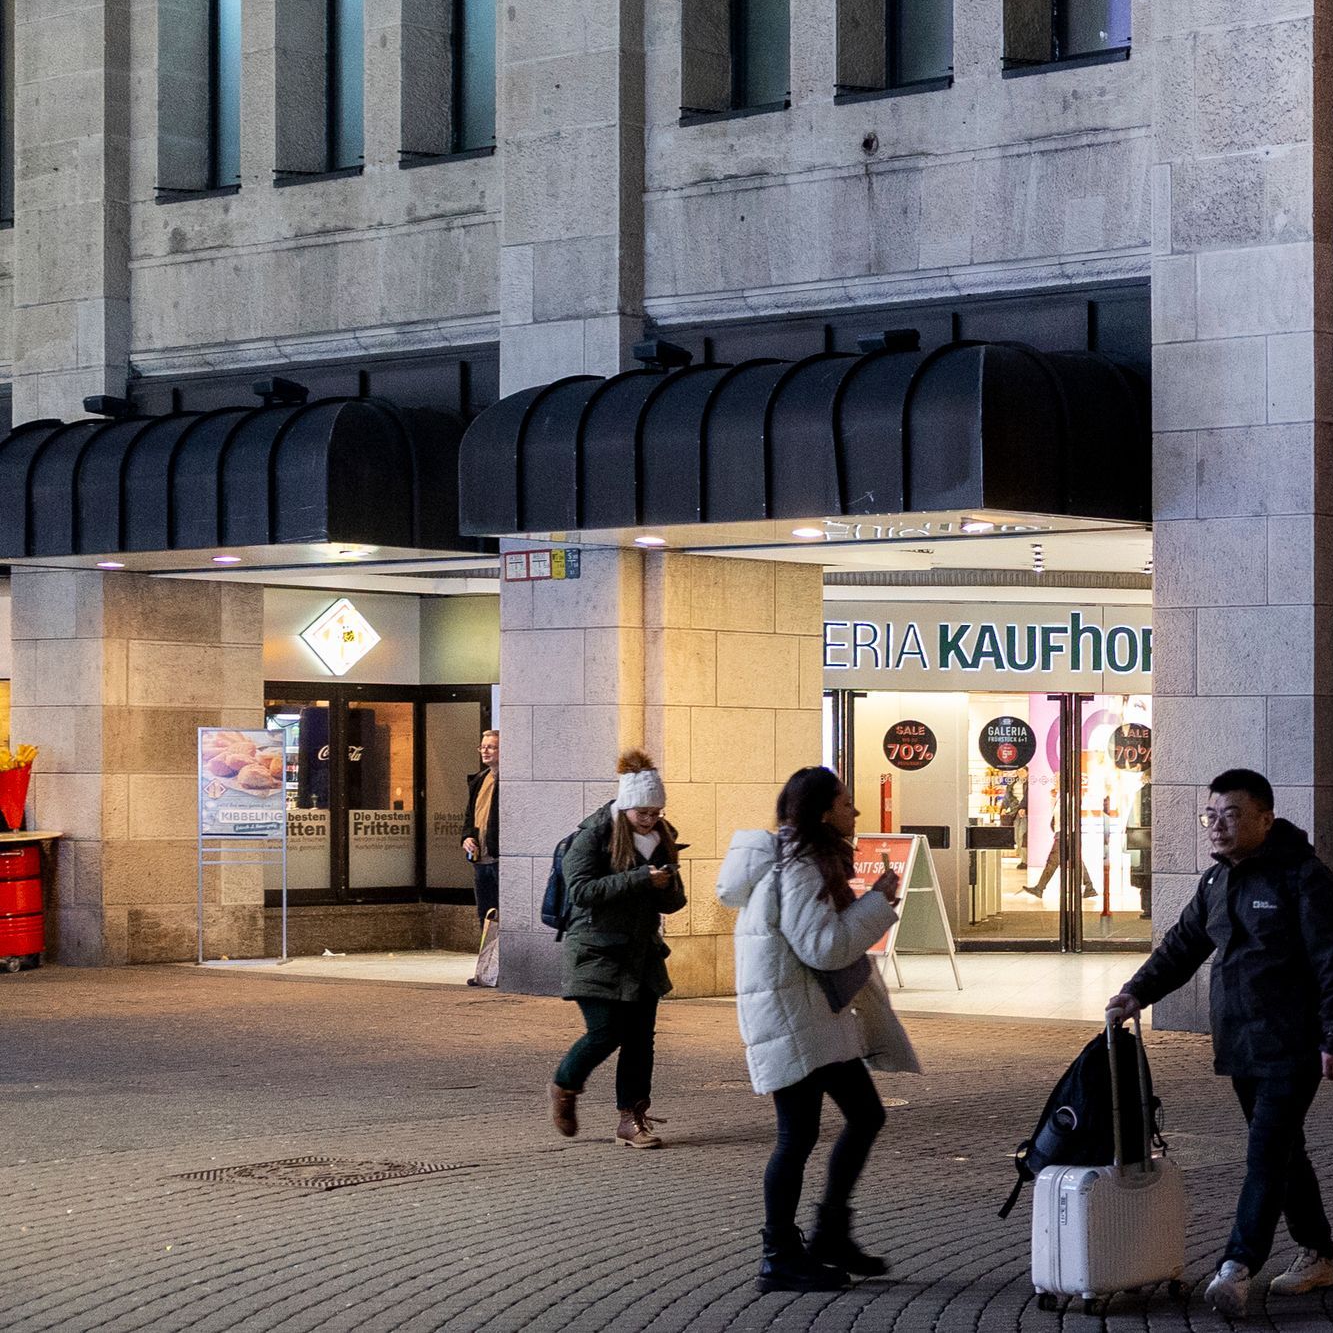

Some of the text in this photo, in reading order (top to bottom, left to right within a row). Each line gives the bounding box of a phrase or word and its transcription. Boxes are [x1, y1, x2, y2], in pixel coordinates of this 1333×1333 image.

[895, 726, 926, 736] SALE
[987, 726, 1028, 736] GALERIA
[1121, 729, 1150, 738] ALE
[887, 743, 934, 761] 70%
[221, 811, 283, 821] KIBBELING
[287, 813, 327, 821] besten
[353, 812, 411, 821] Die besten
[286, 822, 327, 836] itten
[353, 821, 411, 836] Fritten
